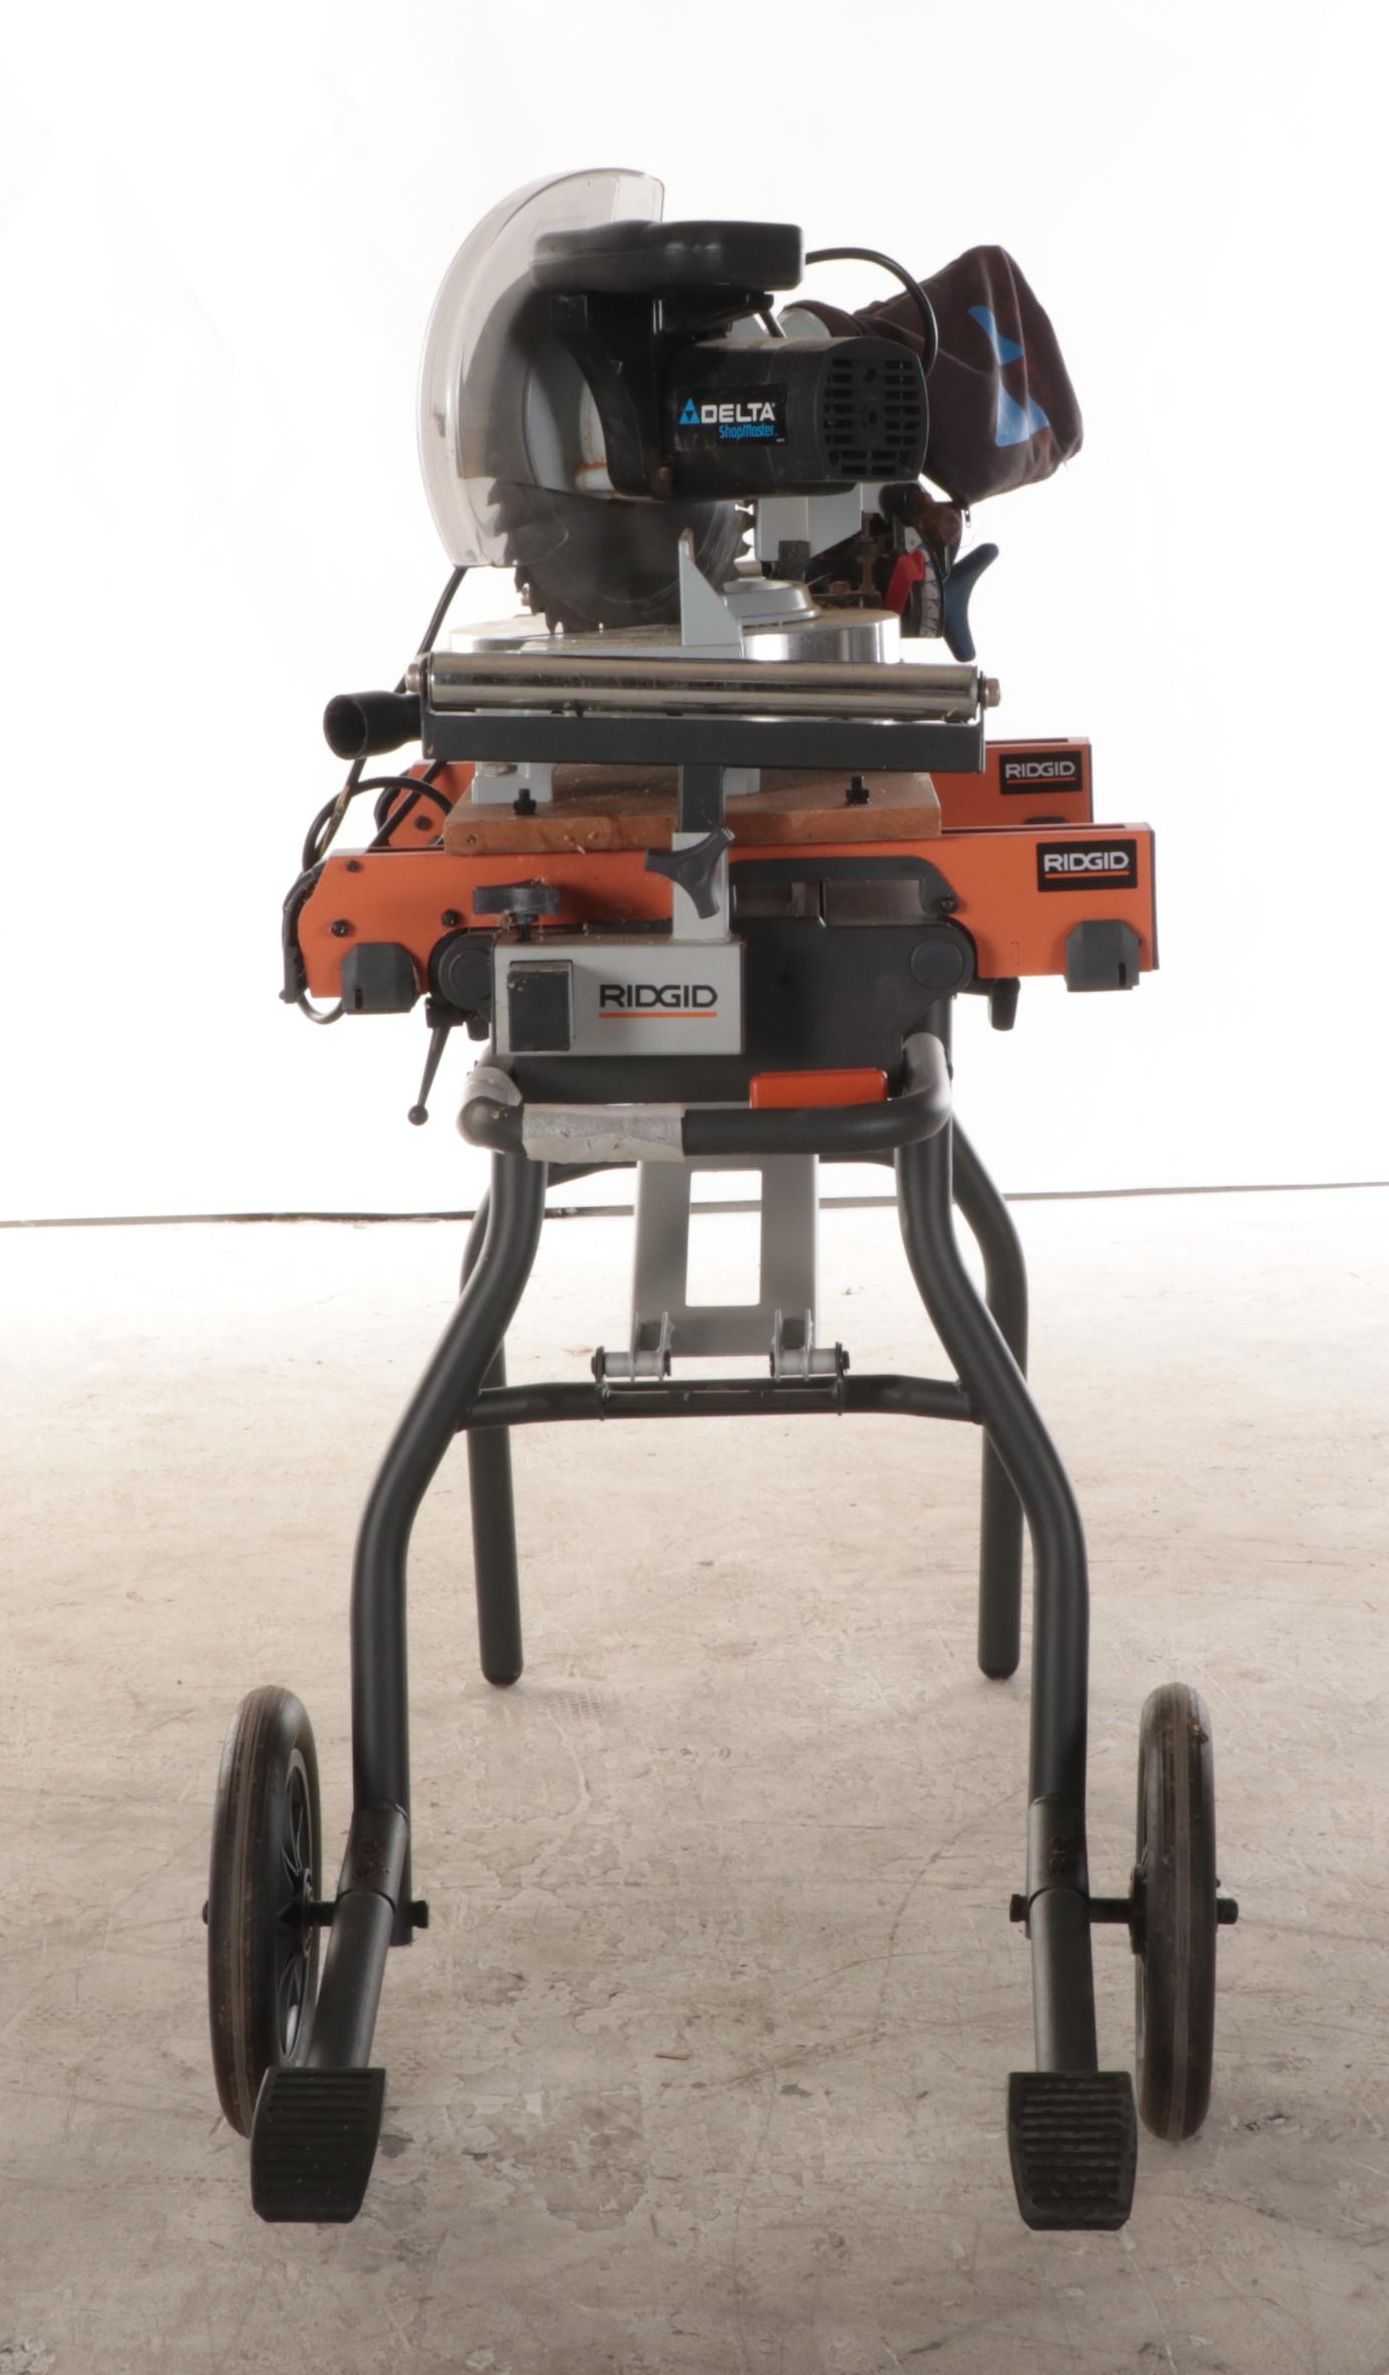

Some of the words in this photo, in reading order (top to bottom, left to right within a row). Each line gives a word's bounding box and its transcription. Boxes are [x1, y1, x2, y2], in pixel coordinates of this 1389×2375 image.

[701, 402, 775, 423] DELTA
[719, 423, 774, 440] ShopMaster
[1005, 761, 1076, 778] RIDGID
[1044, 851, 1129, 872] RIDGID
[599, 984, 718, 1008] RIDGID
